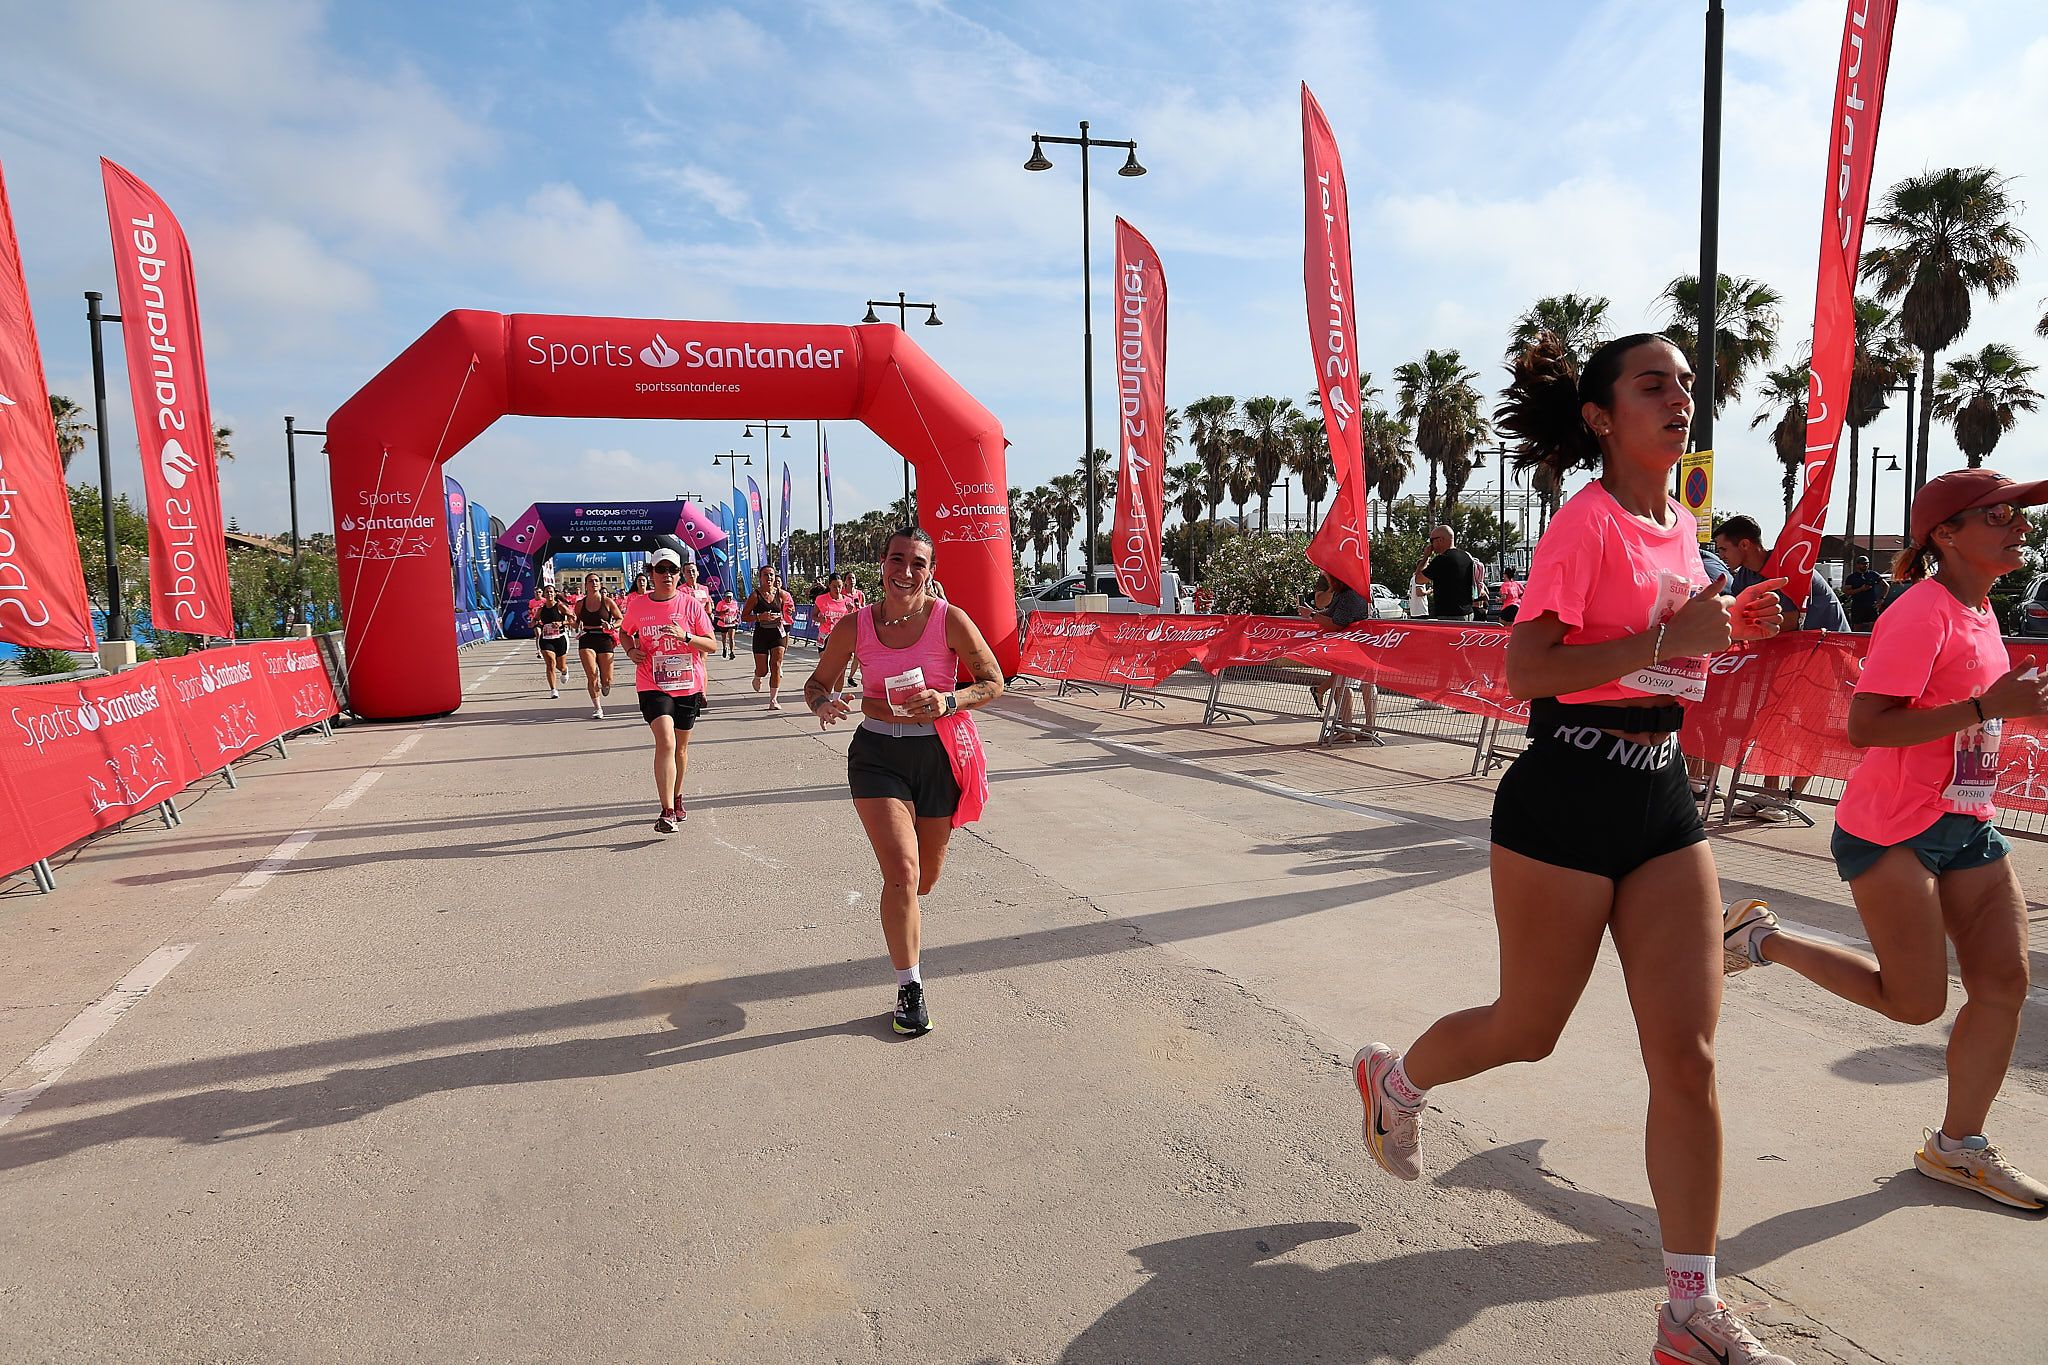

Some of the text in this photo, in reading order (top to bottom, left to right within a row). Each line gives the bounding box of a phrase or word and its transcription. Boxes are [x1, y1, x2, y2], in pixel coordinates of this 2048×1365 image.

[527, 336, 844, 372] Sports Santander
[635, 381, 740, 394] sportssantander.es
[955, 481, 996, 497] Sports
[359, 490, 411, 508] Sports
[585, 508, 649, 518] octopus energy
[357, 515, 435, 530] Santander
[562, 535, 642, 543] VOLVO
[1670, 585, 1690, 596] SUM
[1113, 622, 1224, 643] Sports Santander
[172, 659, 253, 709] Sports Santander
[1638, 674, 1674, 688] OYSHO
[12, 684, 160, 754] Sports Santander
[1606, 738, 1670, 771] NIKE
[1957, 789, 1985, 798] OYSHO
